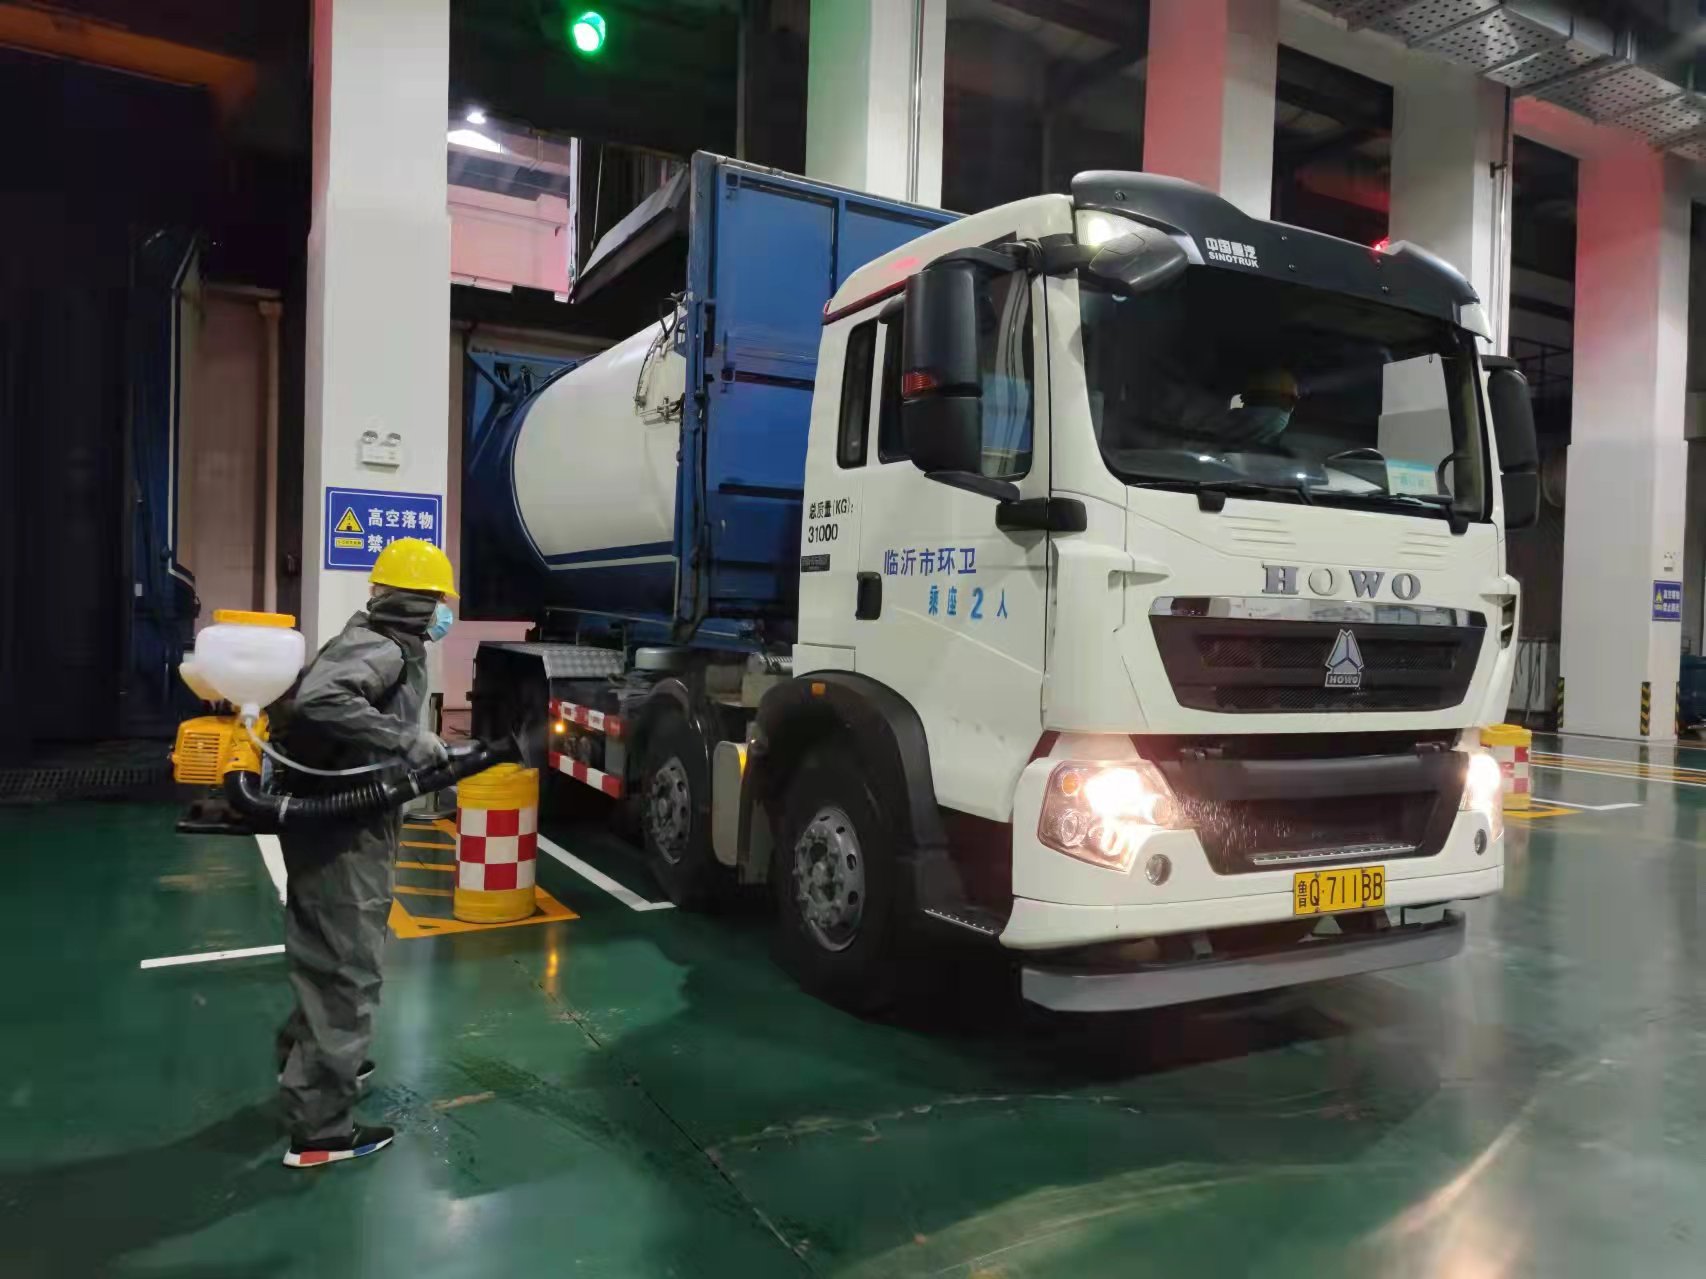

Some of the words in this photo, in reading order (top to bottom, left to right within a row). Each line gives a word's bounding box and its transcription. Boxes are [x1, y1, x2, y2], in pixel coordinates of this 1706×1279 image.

[1208, 251, 1259, 268] SINOTRUK
[368, 508, 433, 529] 高空落物
[808, 523, 839, 543] 31000
[884, 547, 976, 576] 临沂市环卫
[1261, 563, 1421, 600] HOWO
[1329, 675, 1358, 684] HOWO
